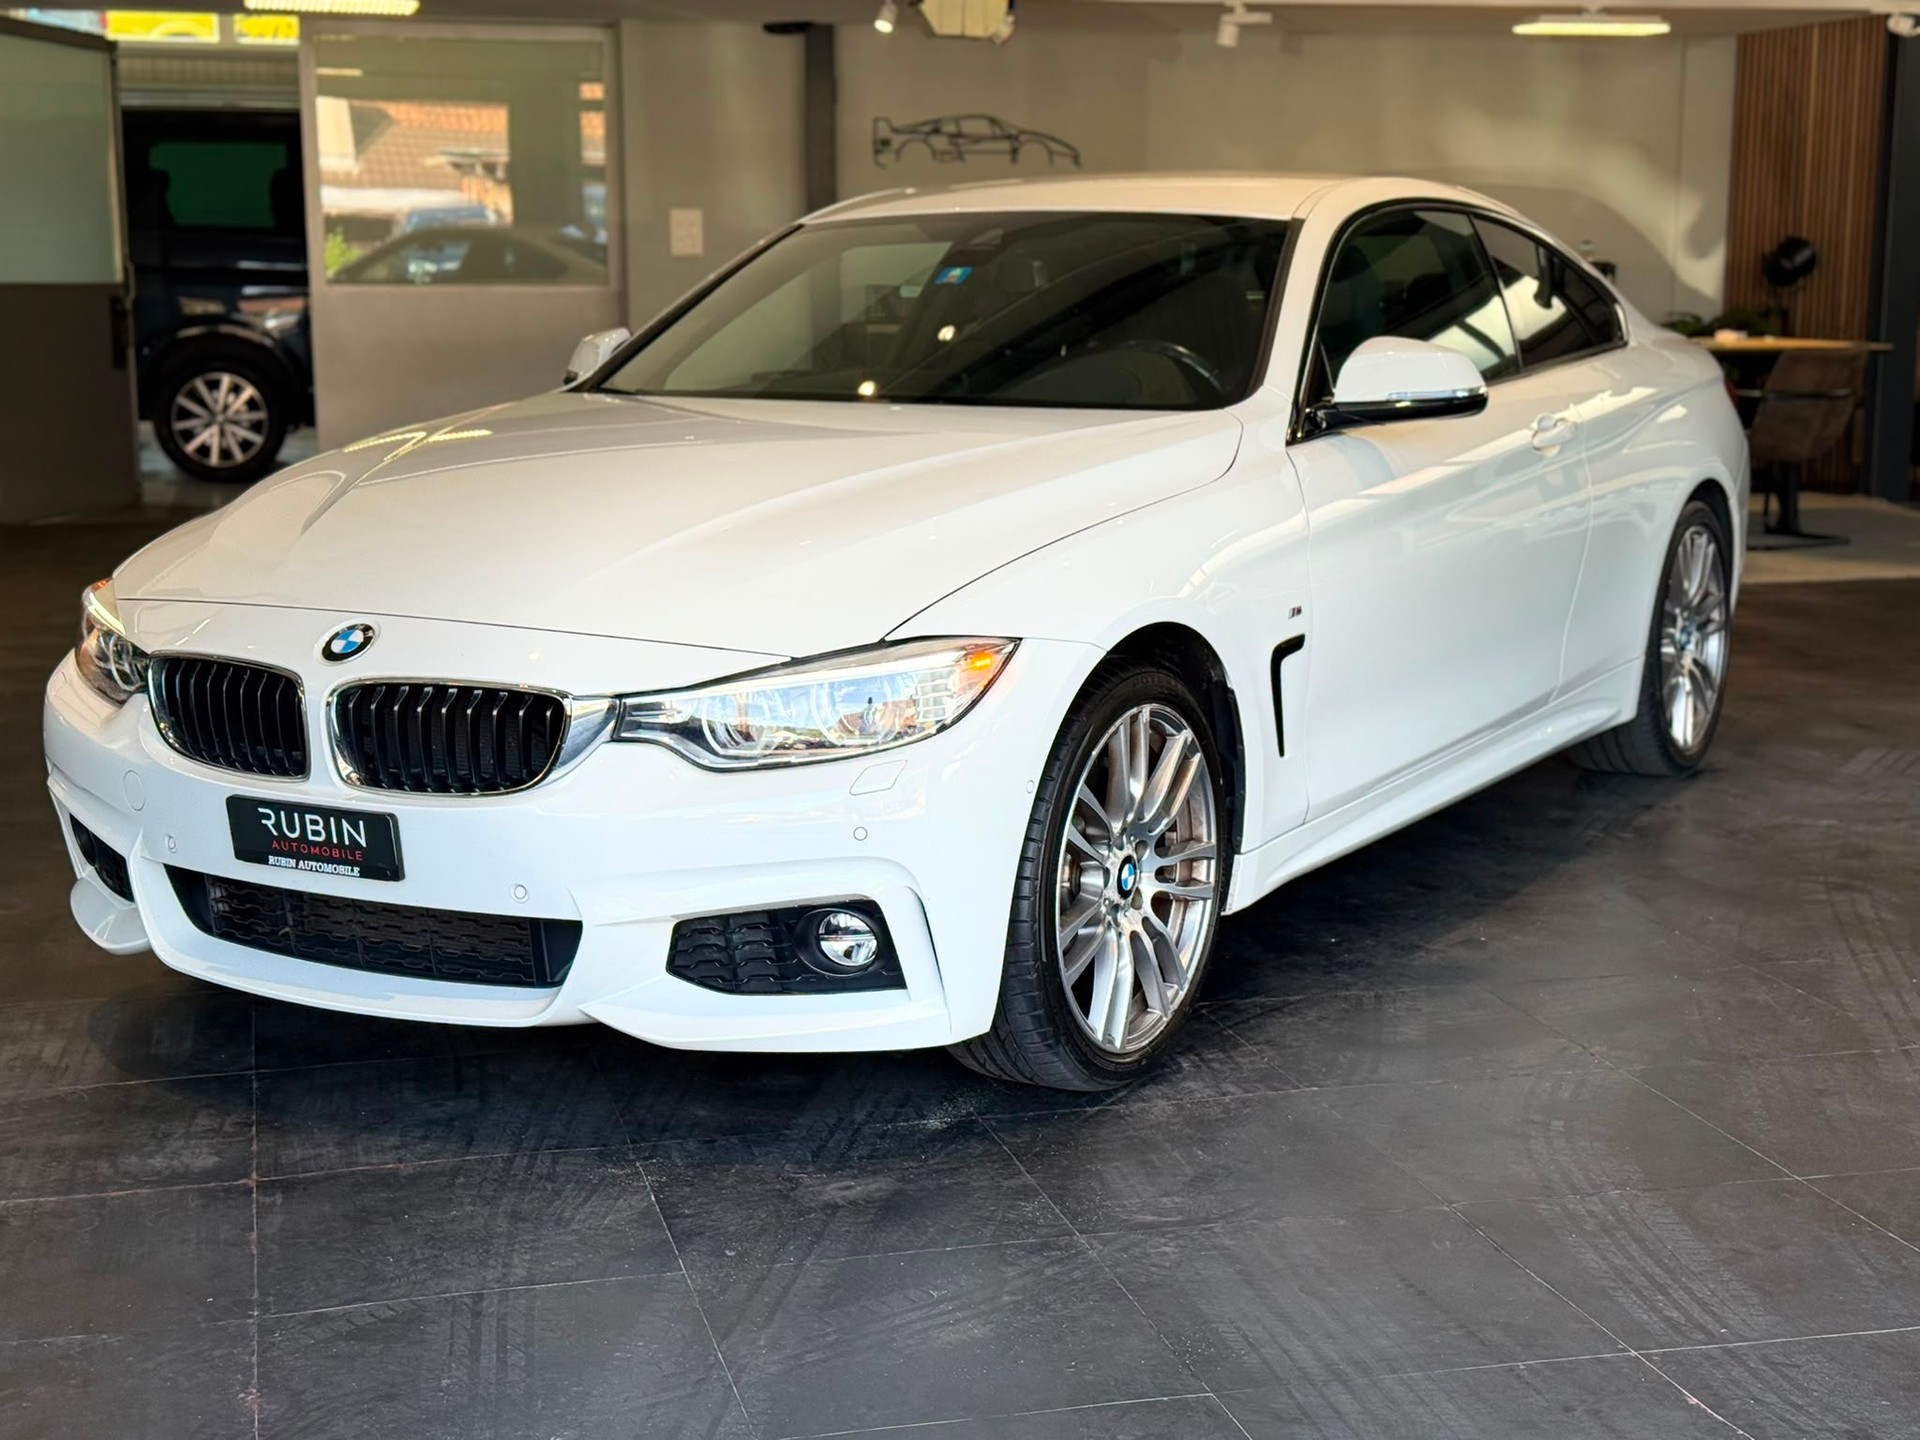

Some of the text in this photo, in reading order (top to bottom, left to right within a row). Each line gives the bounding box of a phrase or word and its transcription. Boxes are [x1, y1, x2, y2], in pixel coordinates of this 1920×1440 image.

[257, 807, 367, 848] RUBIN
[271, 840, 364, 861] AUTOMOBILE
[268, 855, 361, 877] RUBIN AUTOMOBILE
